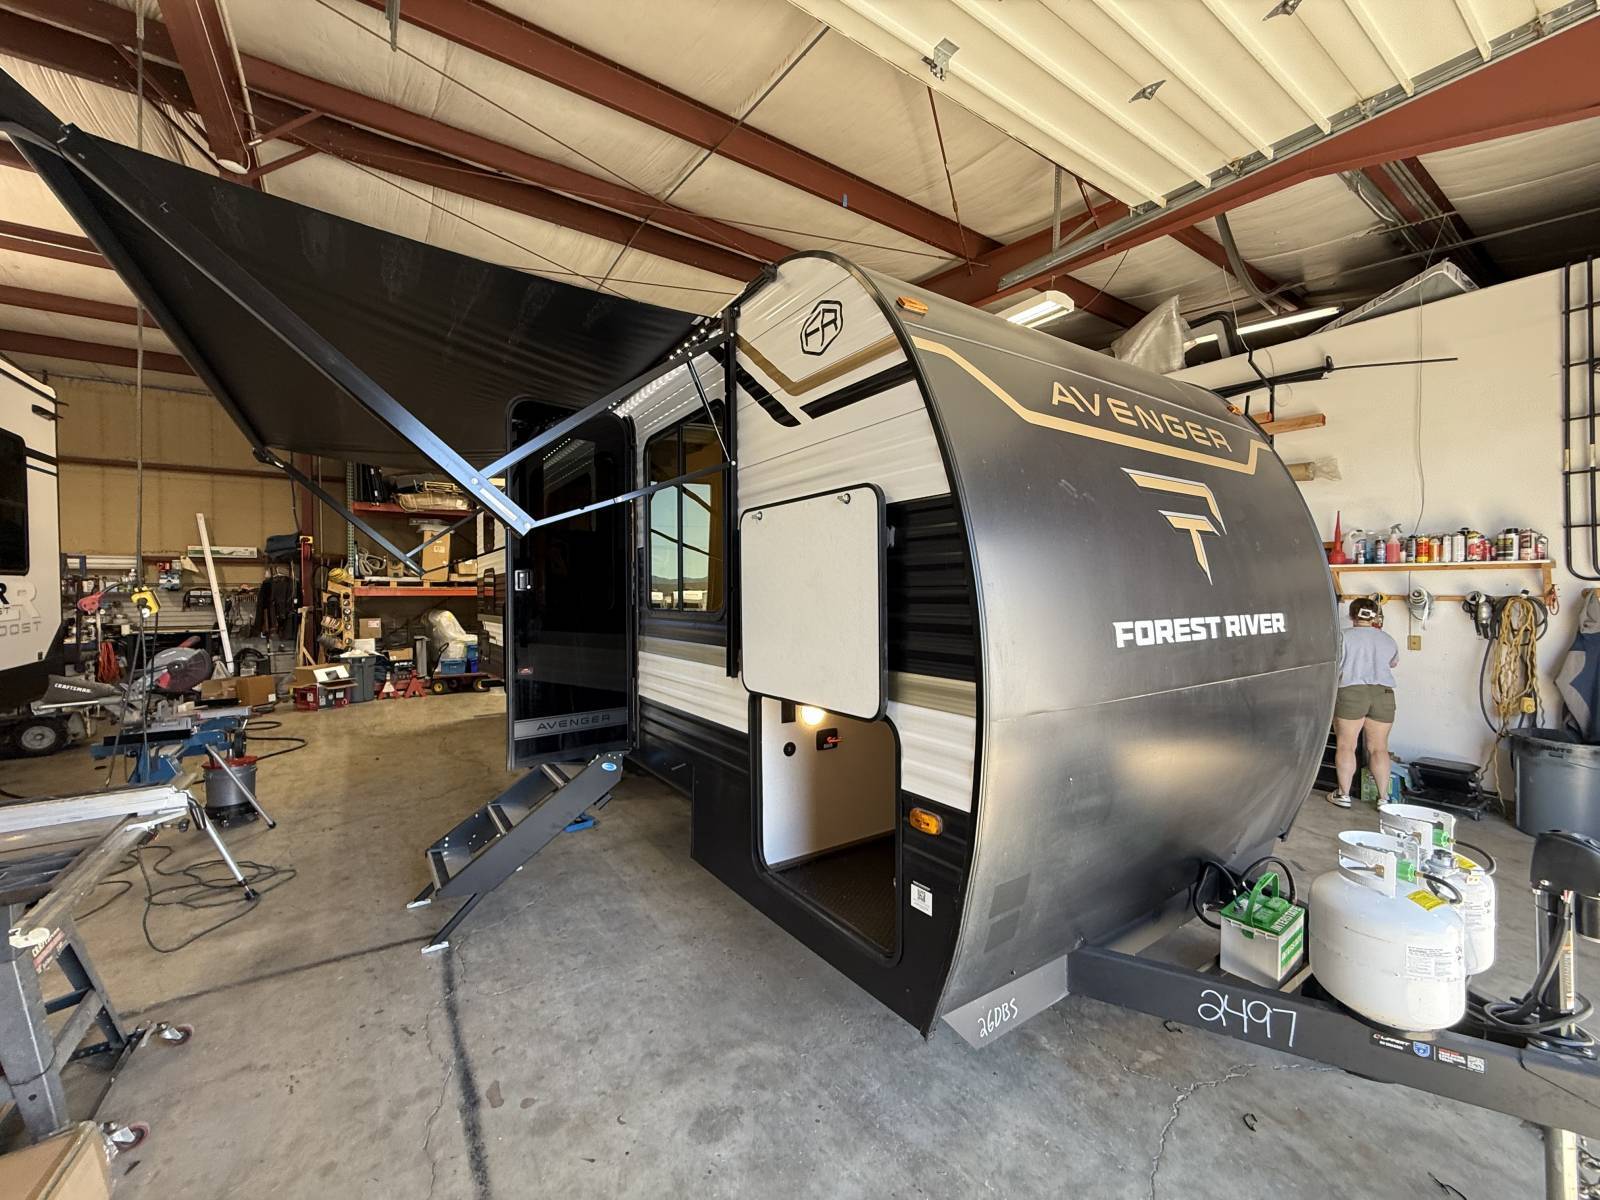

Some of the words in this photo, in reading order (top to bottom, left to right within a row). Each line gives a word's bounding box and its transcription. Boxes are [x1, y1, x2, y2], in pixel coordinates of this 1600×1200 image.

[1051, 381, 1233, 453] AVENGER
[1112, 616, 1221, 648] FOREST
[1223, 612, 1287, 638] RIVER
[536, 714, 610, 731] AVENGER
[977, 997, 1018, 1038] 26DBS
[1198, 989, 1297, 1047] 2497
